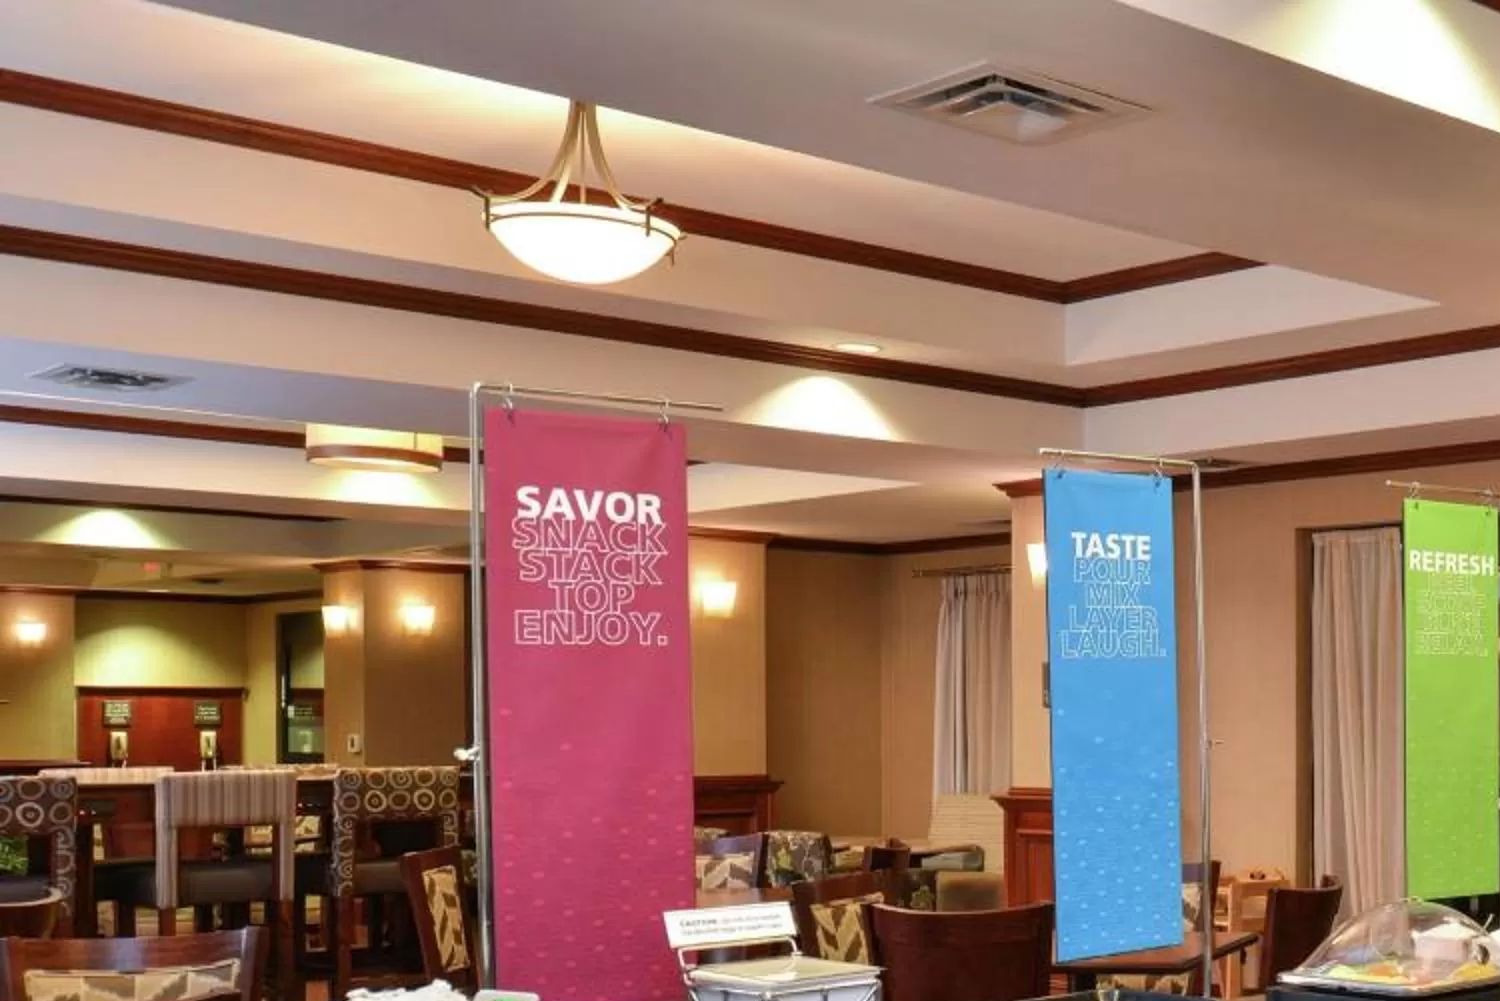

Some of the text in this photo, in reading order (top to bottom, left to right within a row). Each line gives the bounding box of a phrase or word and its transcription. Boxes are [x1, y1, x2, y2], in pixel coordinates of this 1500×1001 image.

[515, 485, 664, 525] SAVOR
[511, 516, 668, 556] SNACK
[1071, 531, 1152, 560] TASTE
[519, 547, 663, 585] STACK
[1073, 557, 1151, 585] POUR
[1409, 549, 1494, 576] REFRESH
[548, 579, 635, 615] TOP
[1086, 581, 1140, 608] MIX
[514, 609, 668, 647] ENJOY.
[1068, 604, 1159, 633] LAYER
[1060, 629, 1167, 659] LAUGH.
